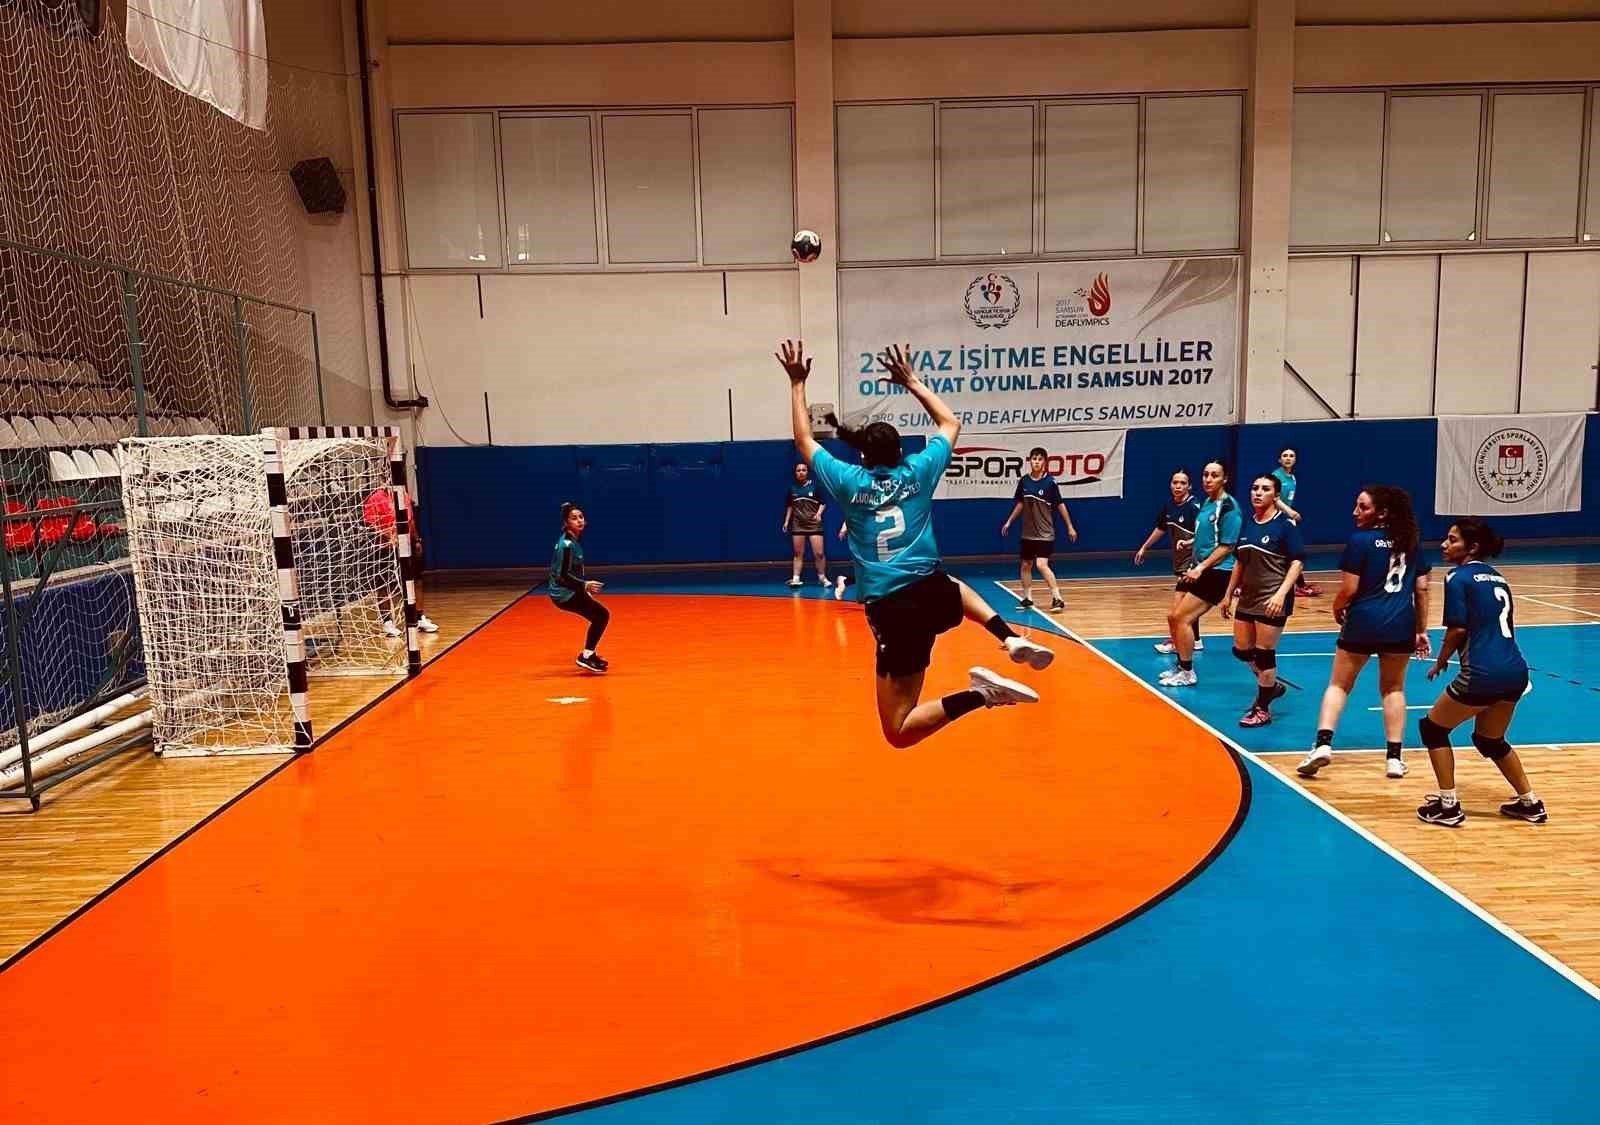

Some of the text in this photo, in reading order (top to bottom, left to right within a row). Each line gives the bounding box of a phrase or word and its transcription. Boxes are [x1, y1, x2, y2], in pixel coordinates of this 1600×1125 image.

[1055, 318, 1110, 328] DEAFLYMPICS
[960, 344, 1046, 376] İŞİTME
[1053, 337, 1213, 367] ENGELLİLER
[859, 368, 1213, 396] OLİMİYAT OYUNLARI SAMSUN 2017
[900, 411, 973, 427] SUMER
[977, 407, 1094, 425] DEAFLYMPICS
[1098, 404, 1171, 420] SAMSUN
[1174, 403, 1213, 418] 2017
[875, 505, 905, 562] 2
